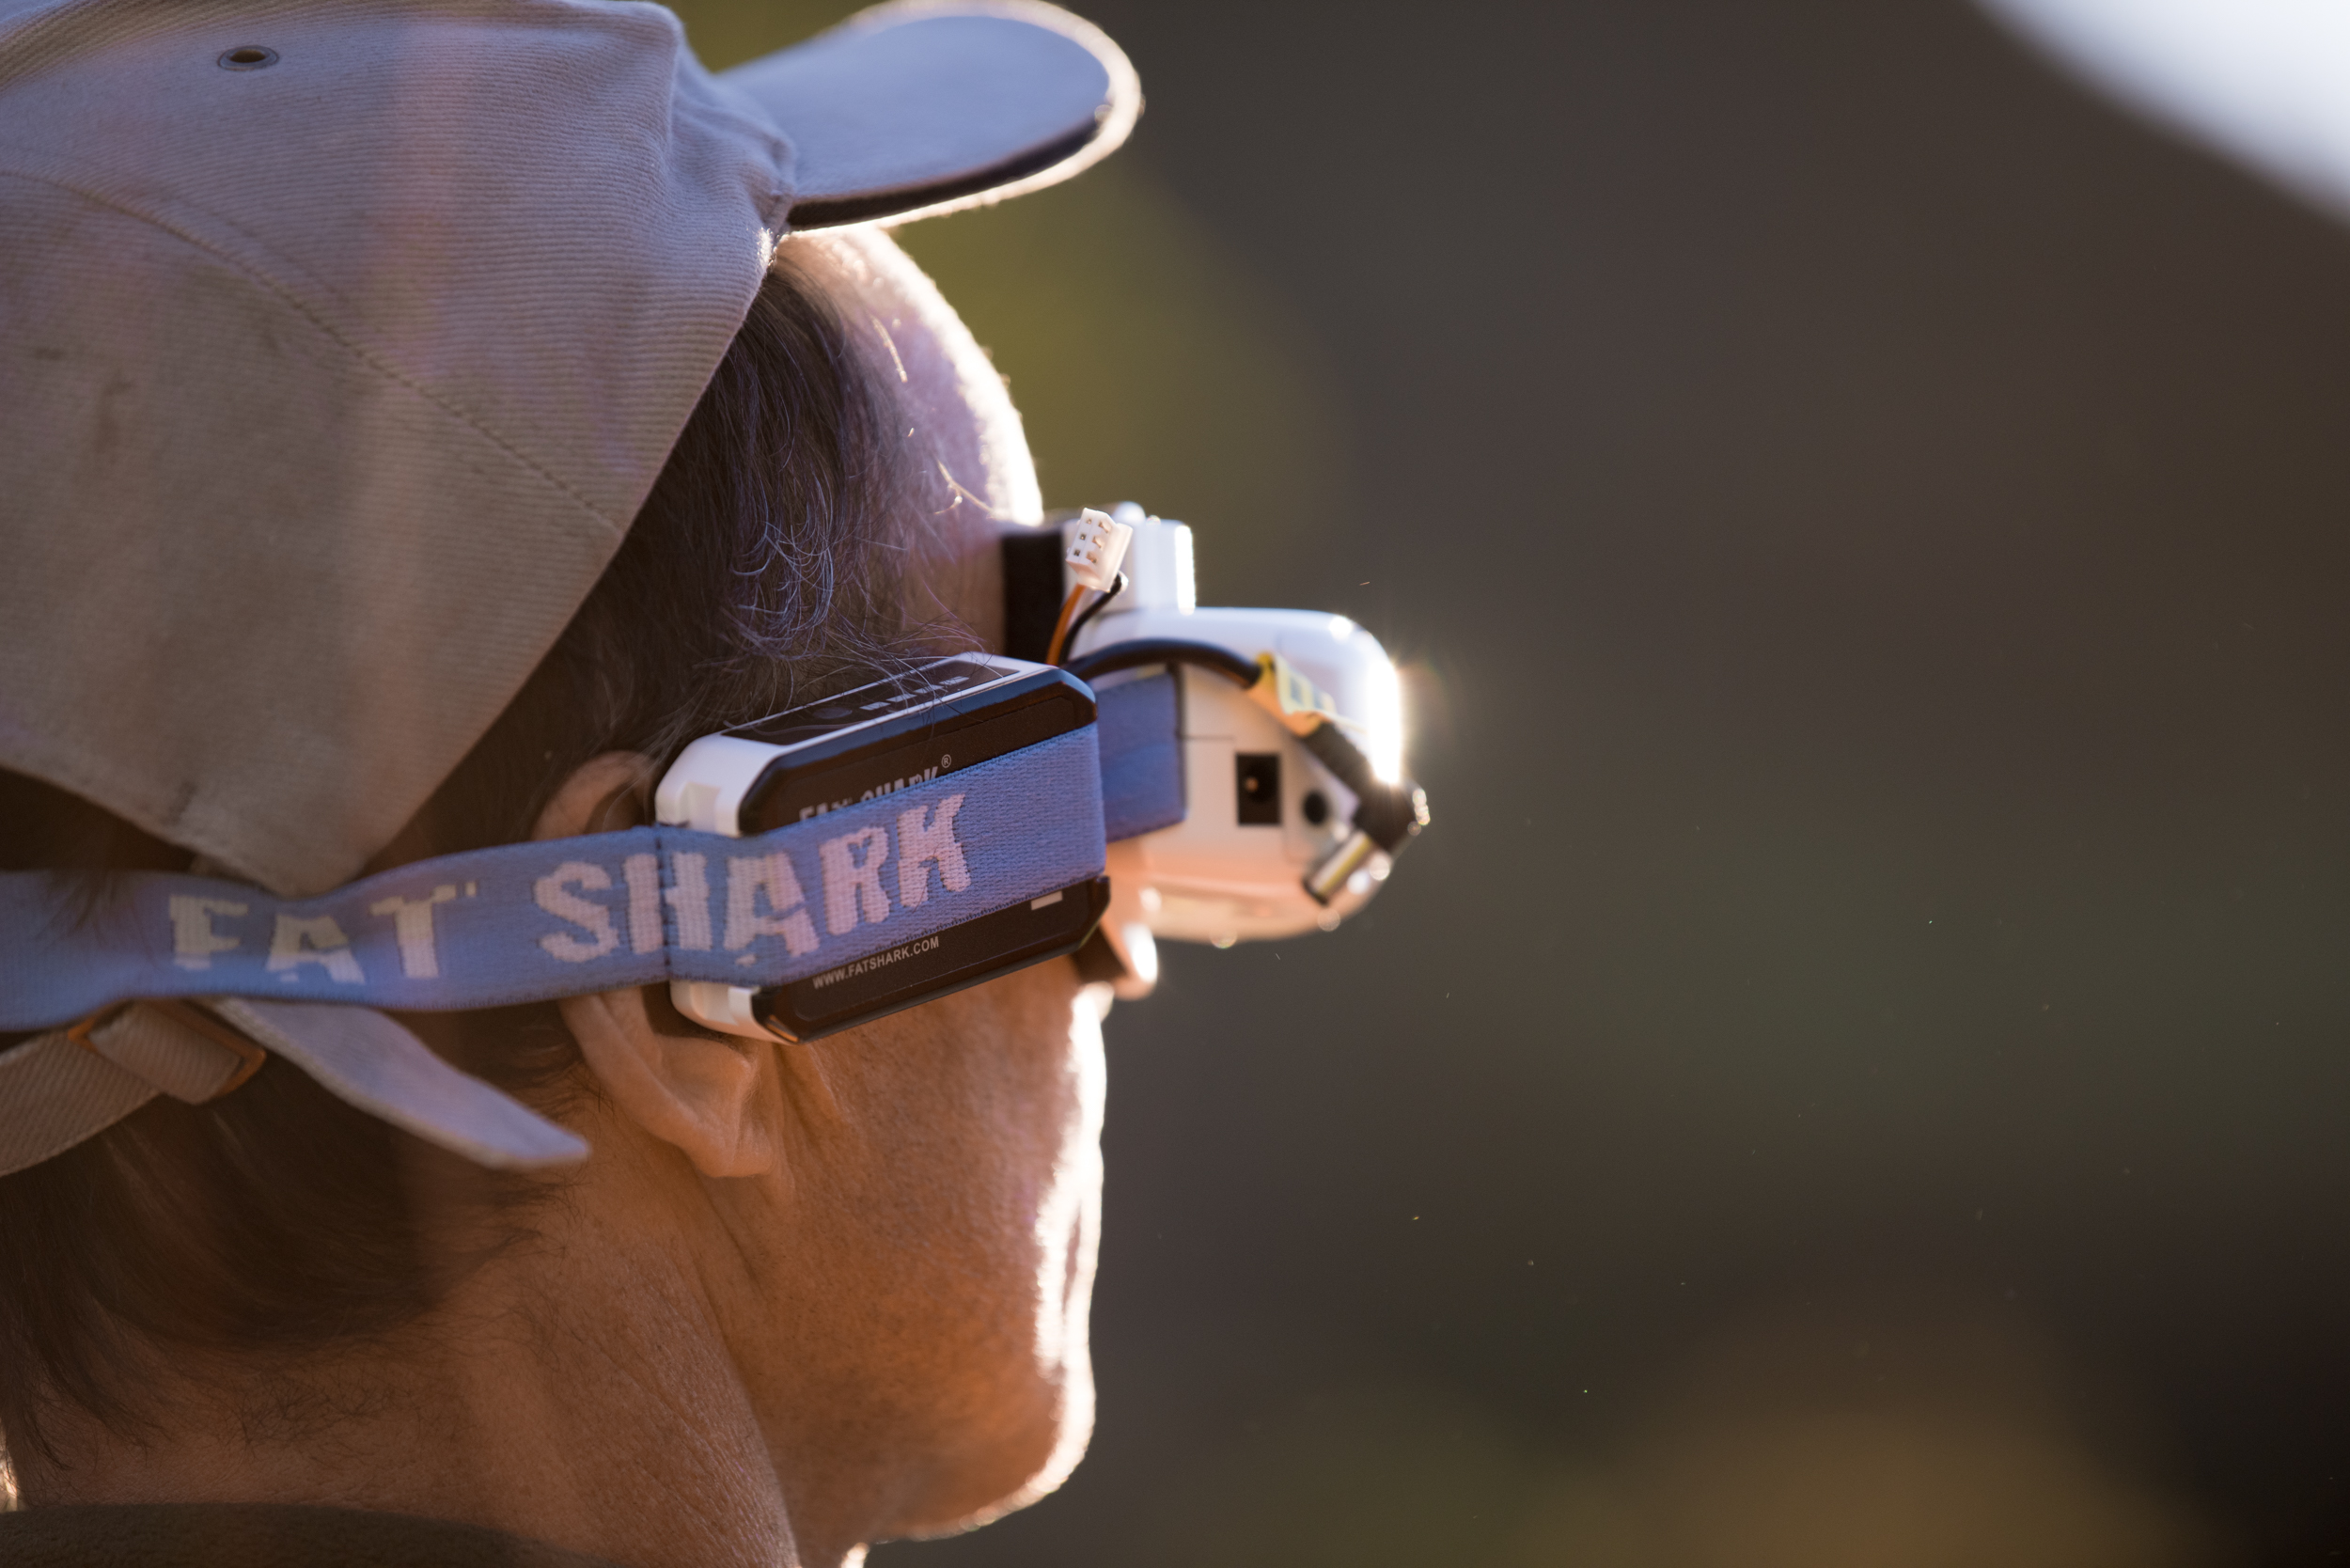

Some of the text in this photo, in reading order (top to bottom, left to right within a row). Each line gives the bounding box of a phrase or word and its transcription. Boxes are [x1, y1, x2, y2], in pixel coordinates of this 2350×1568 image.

[169, 793, 972, 984] FAT SHARK
[812, 935, 939, 990] WWW.FATSHARK.COM
